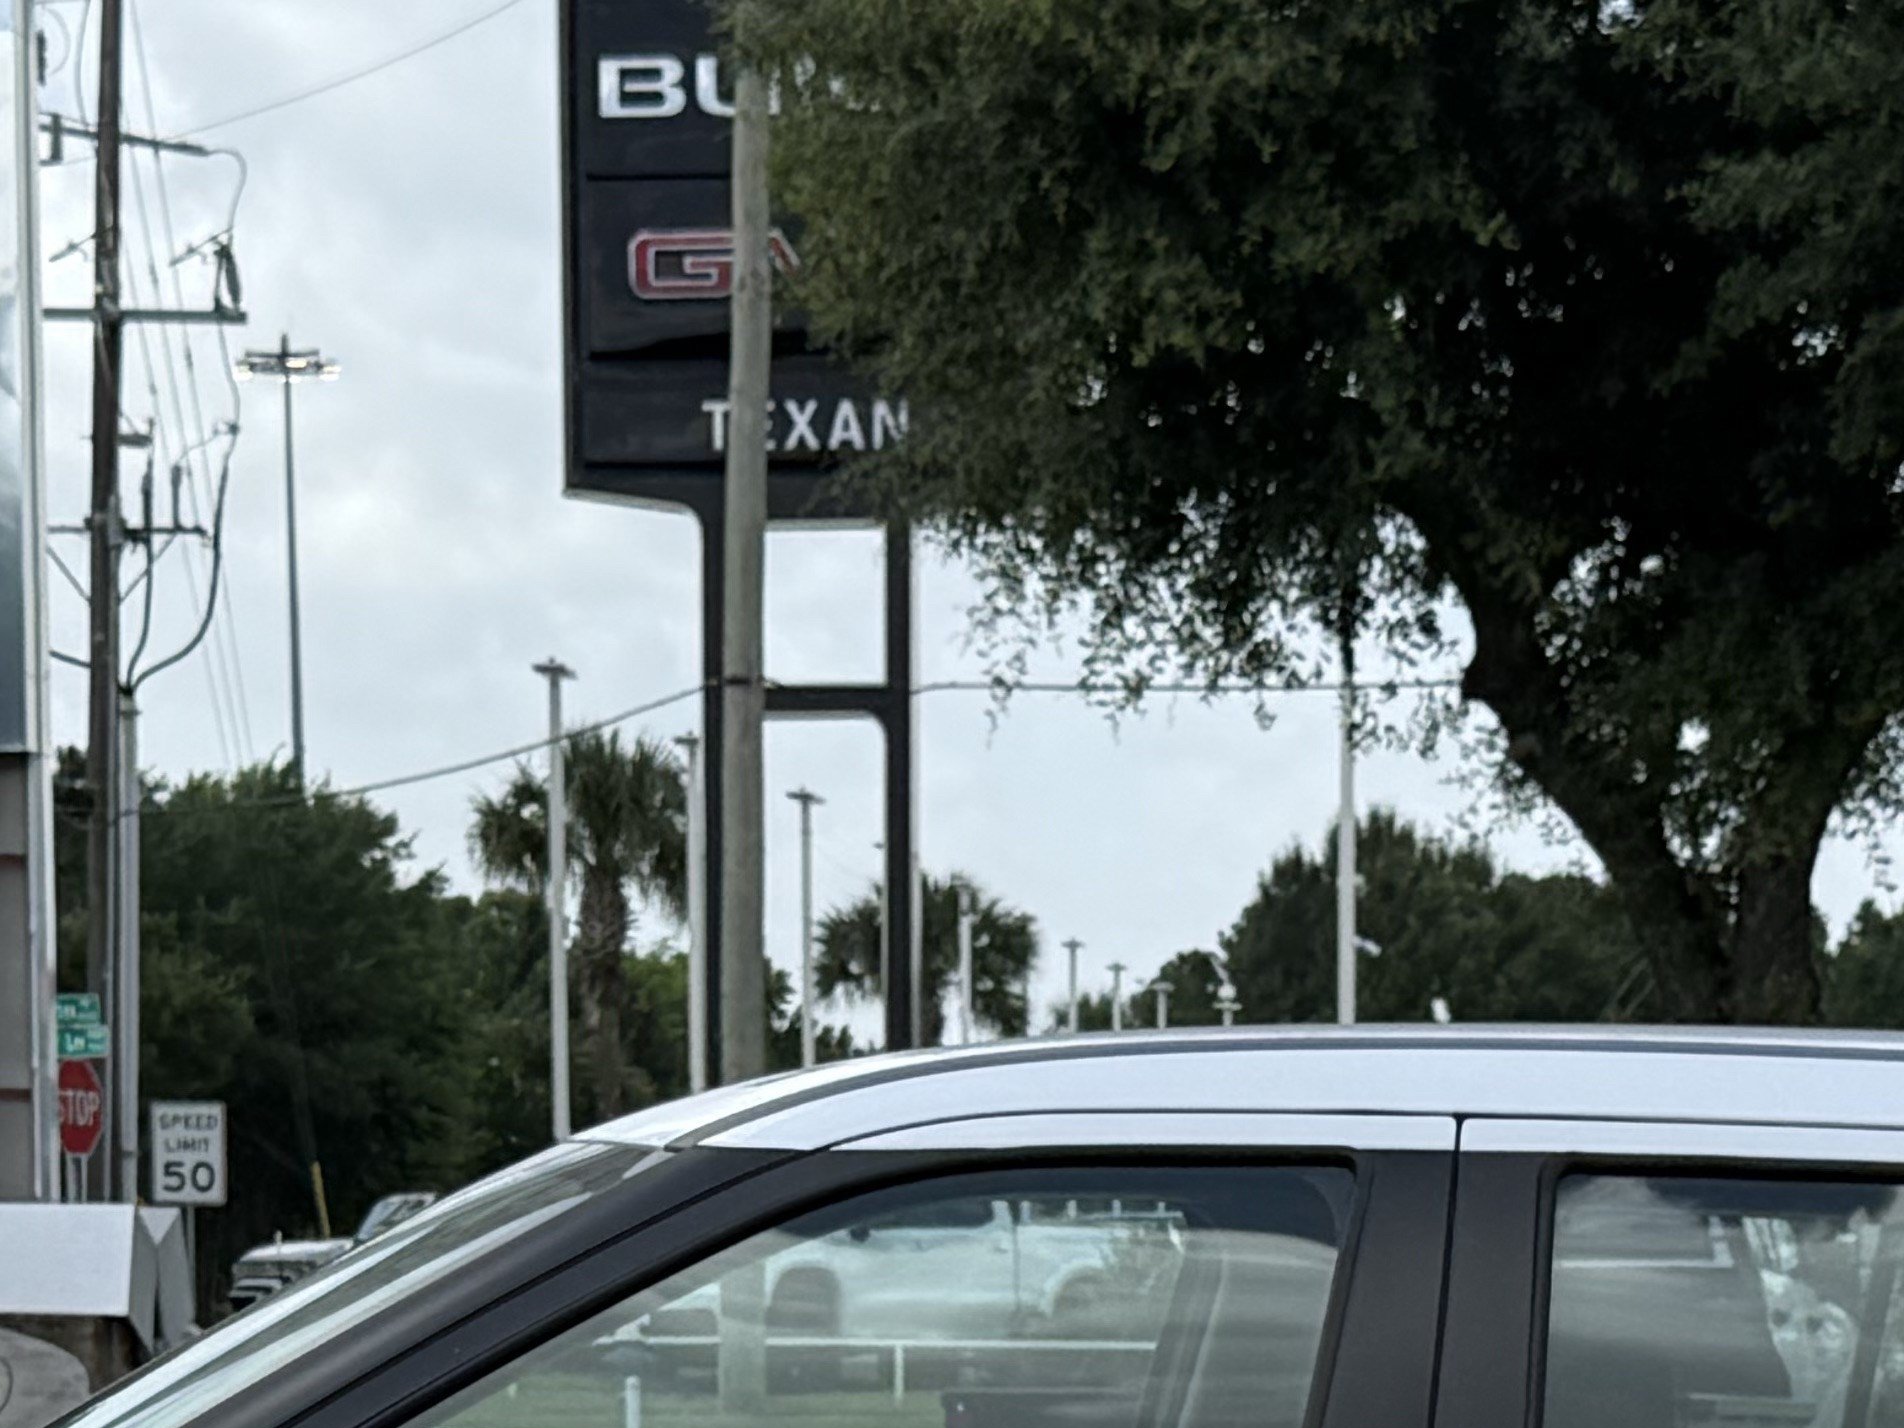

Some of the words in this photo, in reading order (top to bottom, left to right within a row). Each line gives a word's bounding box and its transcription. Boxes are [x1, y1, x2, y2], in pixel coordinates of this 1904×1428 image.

[159, 1112, 218, 1131] SPEED
[164, 1137, 210, 1153] LIMIT
[162, 1161, 216, 1194] 50
